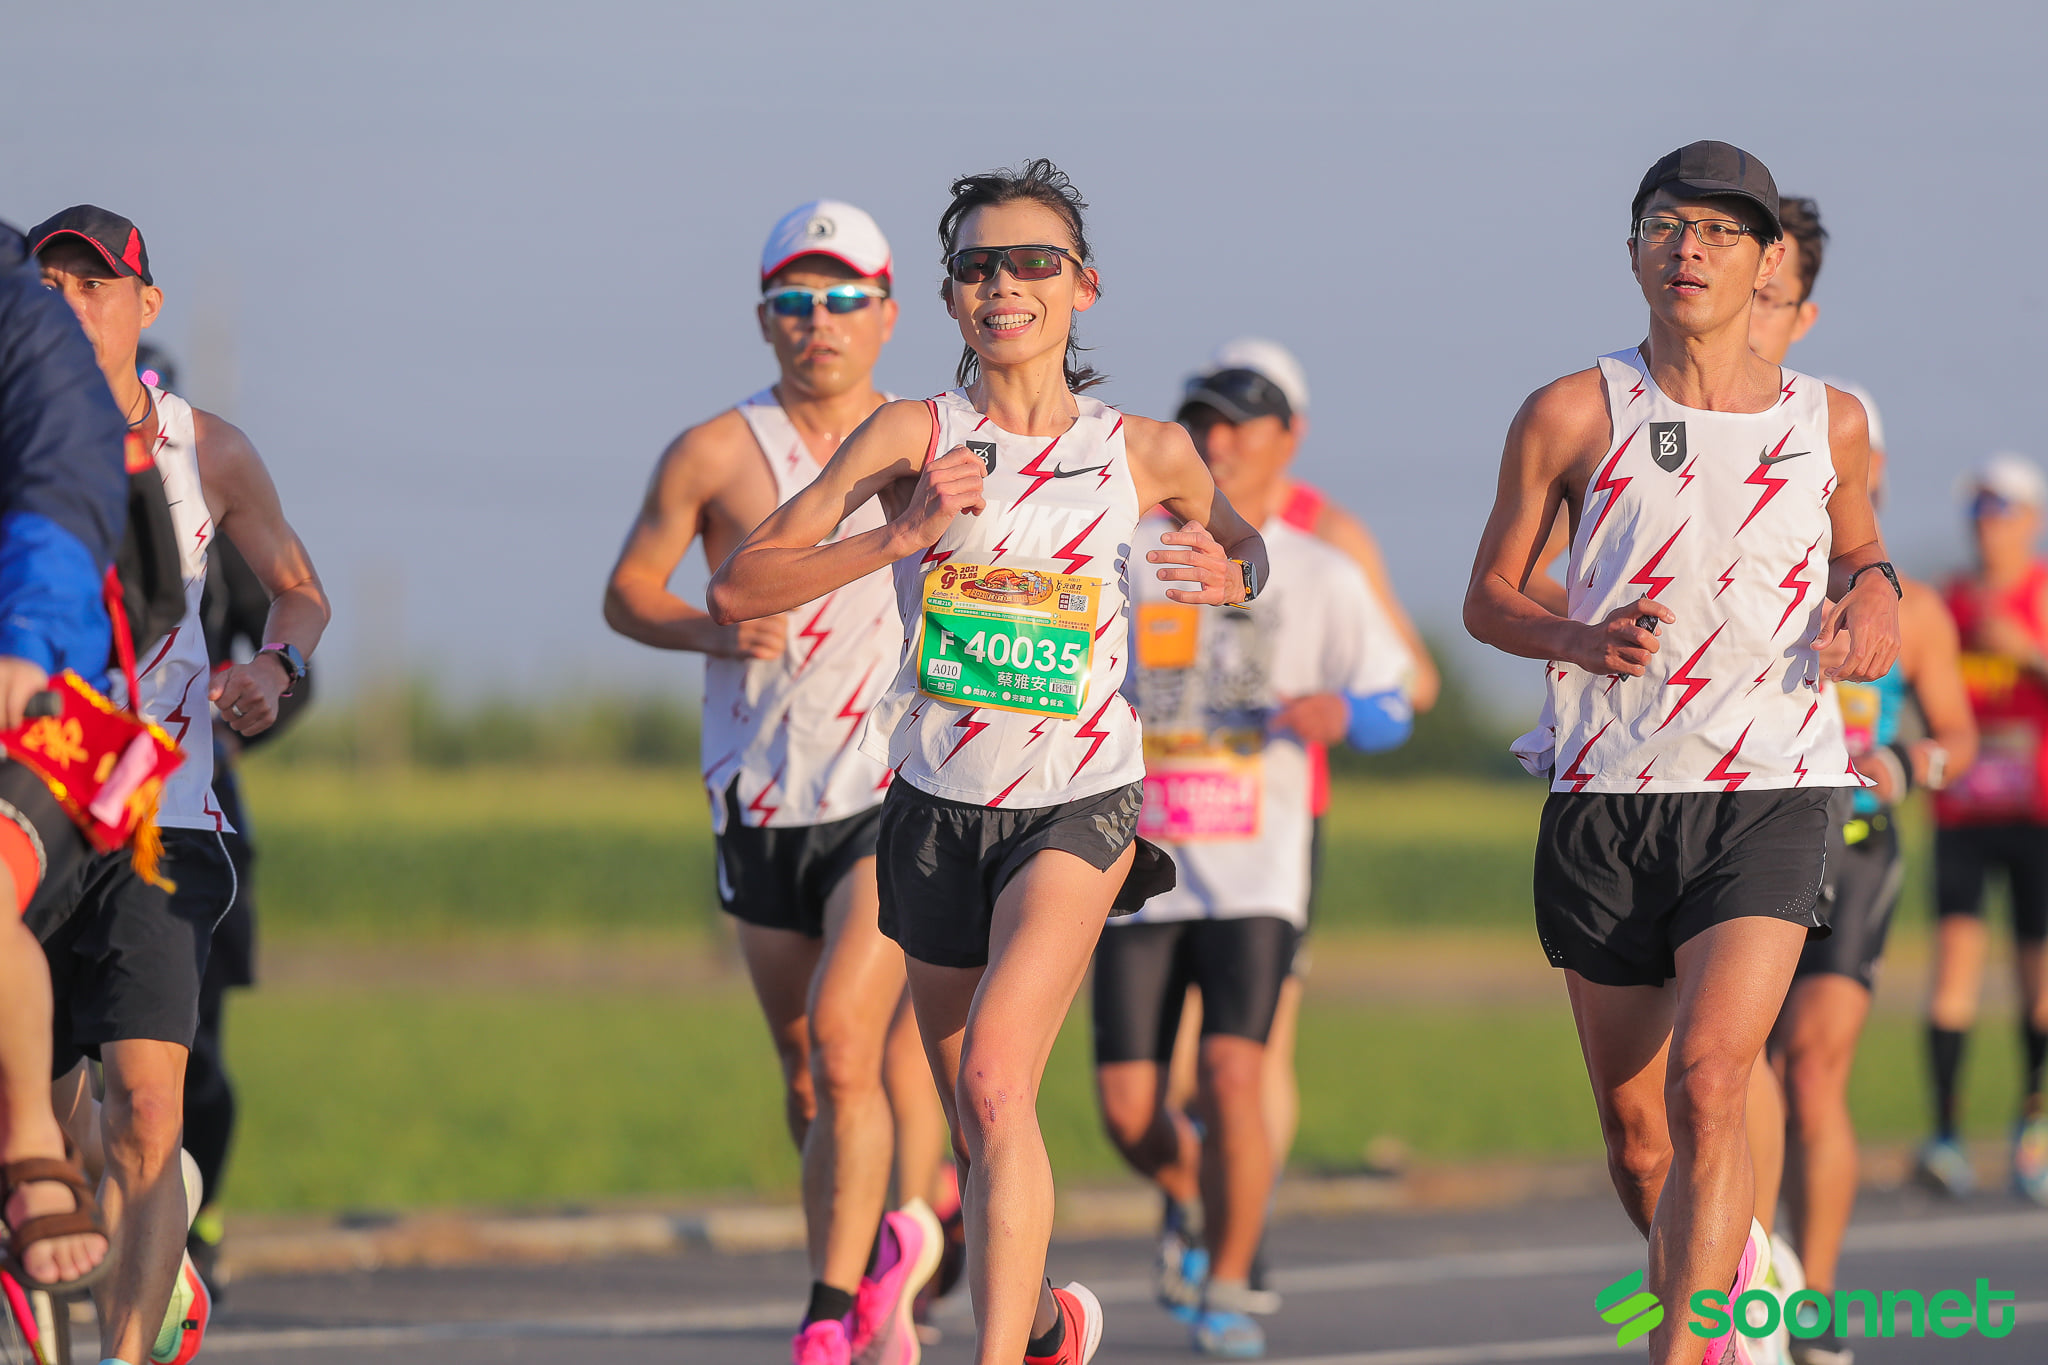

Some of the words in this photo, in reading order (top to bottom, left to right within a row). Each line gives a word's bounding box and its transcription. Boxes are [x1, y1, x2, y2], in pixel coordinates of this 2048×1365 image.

[959, 565, 979, 573] 2021
[939, 629, 955, 656] F
[963, 630, 1083, 675] 40035
[931, 663, 958, 677] A010
[997, 670, 1047, 693] 蔡雅安
